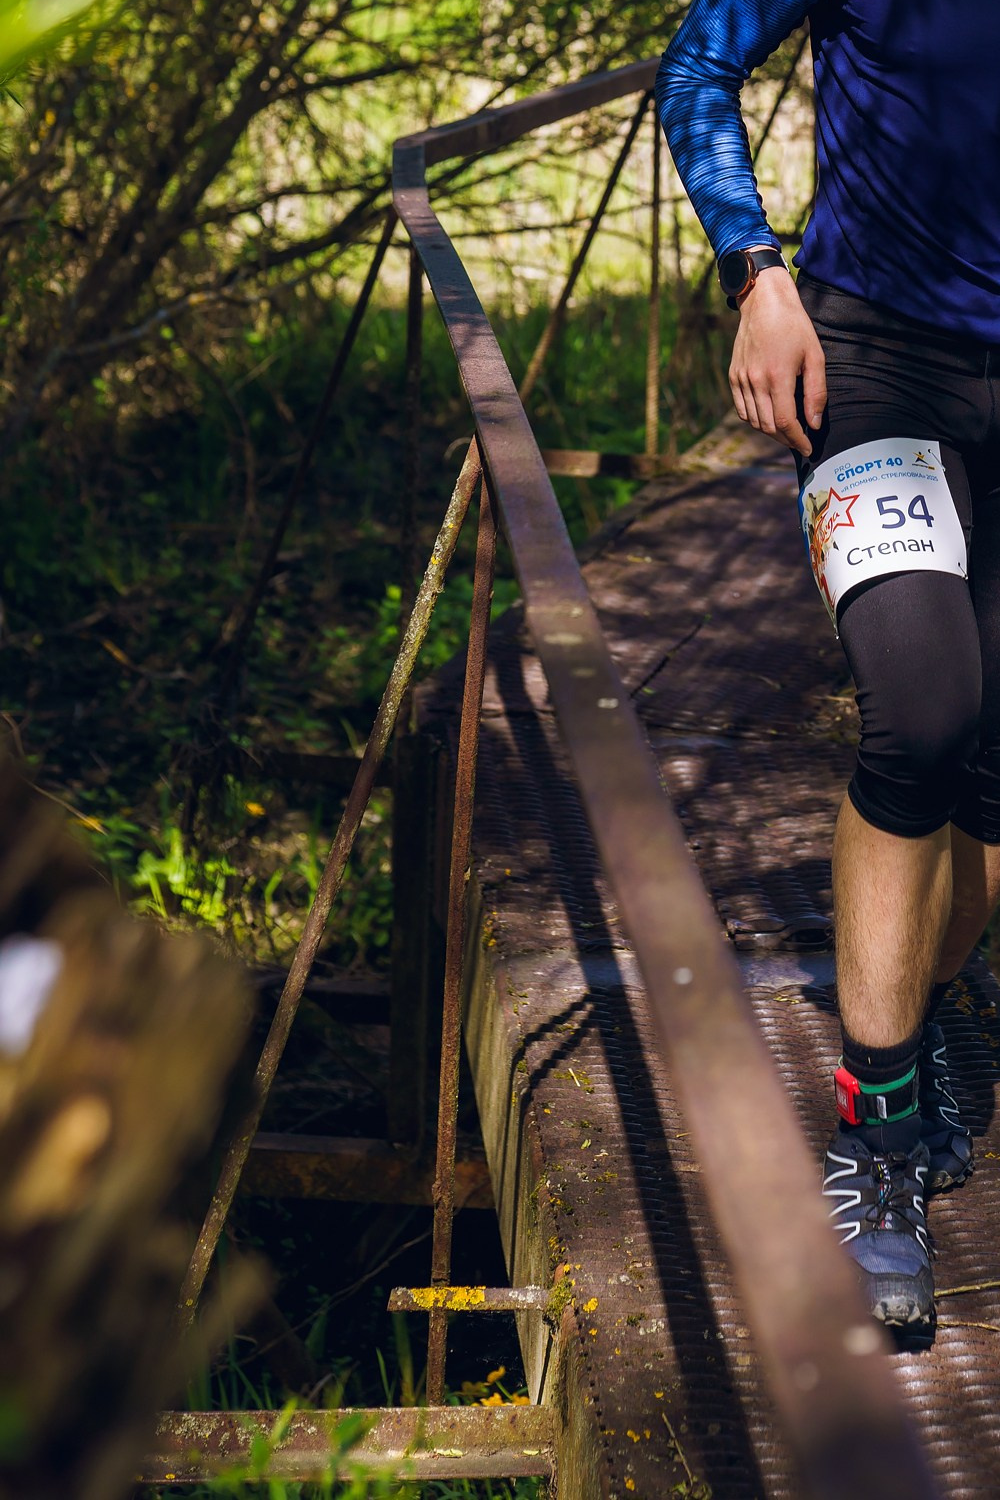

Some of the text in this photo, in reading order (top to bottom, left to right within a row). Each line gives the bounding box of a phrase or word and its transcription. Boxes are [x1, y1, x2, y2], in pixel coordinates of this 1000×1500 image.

[834, 463, 851, 474] PRO
[836, 459, 882, 482] СПОРТ
[886, 457, 903, 467] 40
[876, 494, 934, 529] 54
[847, 539, 935, 566] Степан
